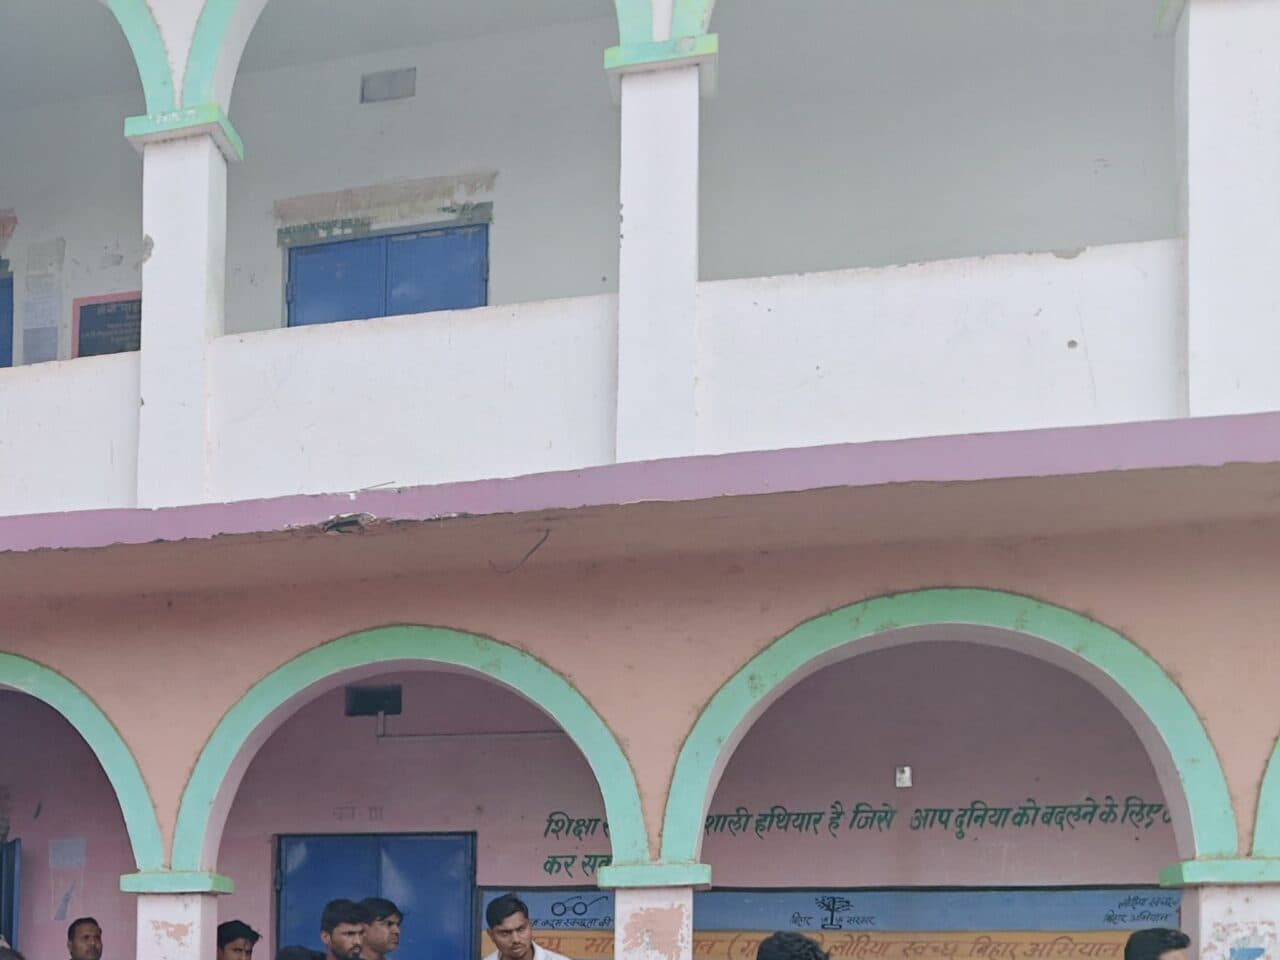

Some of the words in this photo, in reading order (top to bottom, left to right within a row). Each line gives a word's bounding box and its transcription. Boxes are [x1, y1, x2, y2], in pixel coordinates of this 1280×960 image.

[544, 811, 601, 841] शिक्षा
[755, 805, 824, 842] हथियार
[825, 800, 846, 838] है
[849, 802, 897, 832] जिसे
[910, 806, 952, 831] आप
[954, 800, 1011, 840] दुनिया
[1012, 798, 1040, 828] को
[1041, 796, 1099, 831] बदलने
[1099, 796, 1118, 824] के
[1121, 796, 1163, 829] लिए
[544, 855, 577, 879] कर
